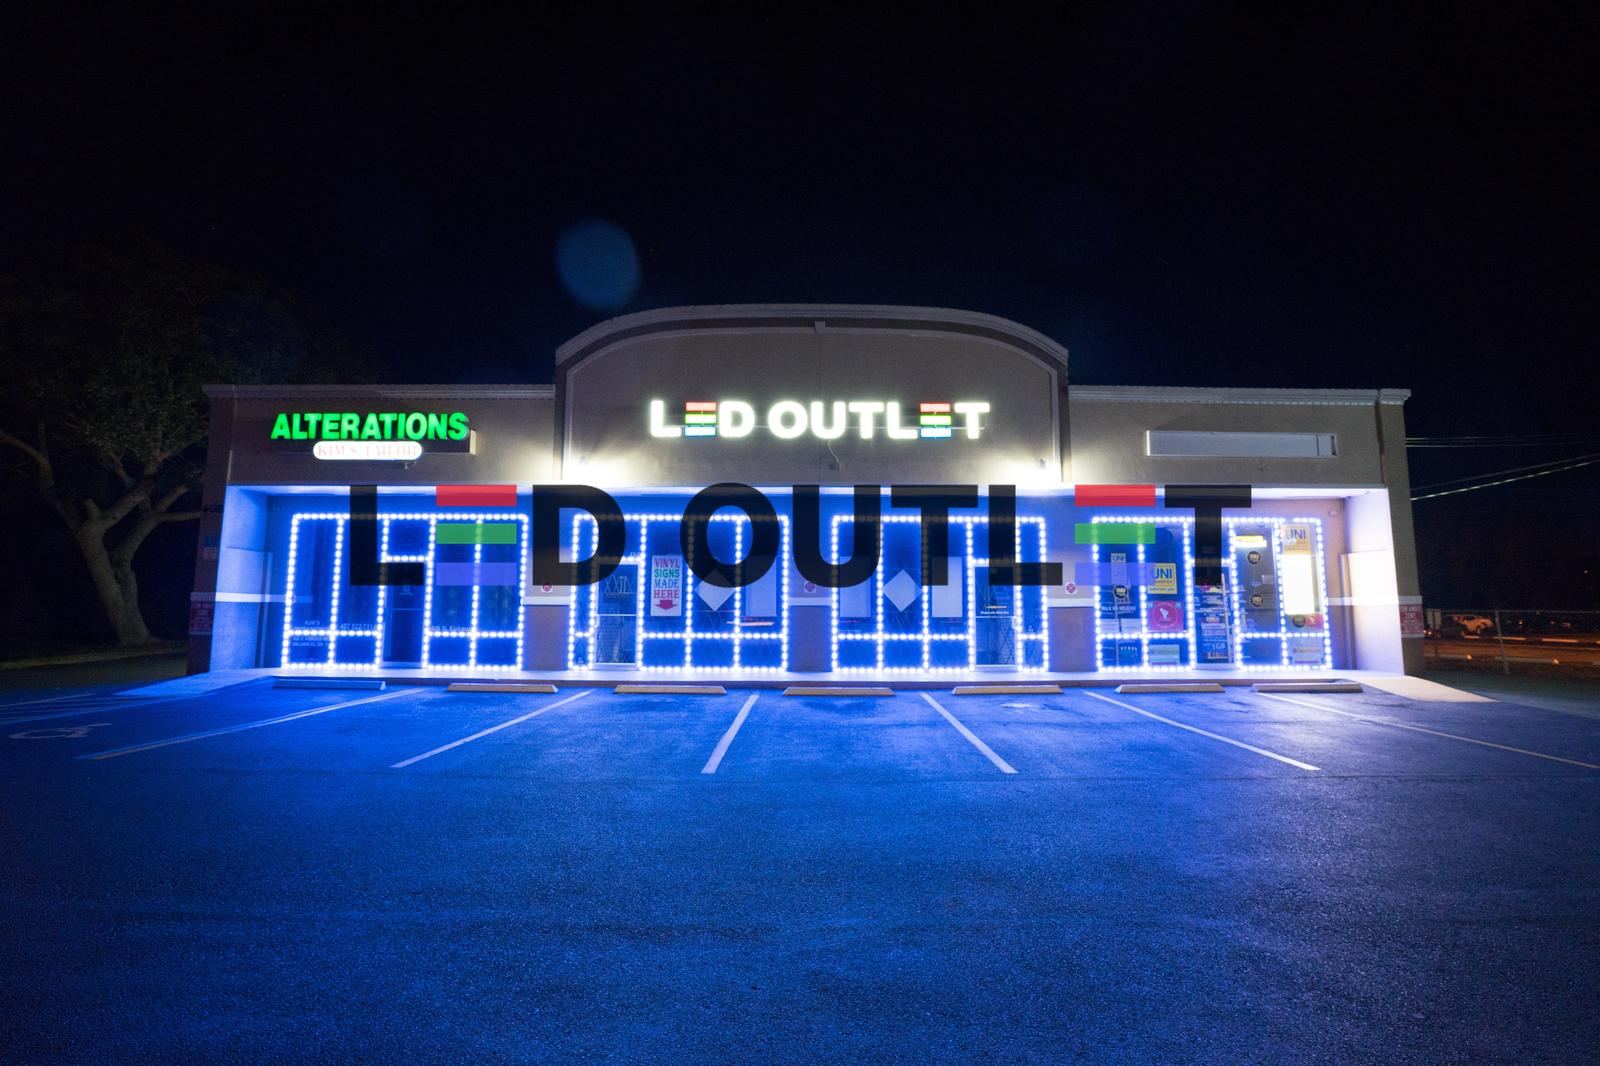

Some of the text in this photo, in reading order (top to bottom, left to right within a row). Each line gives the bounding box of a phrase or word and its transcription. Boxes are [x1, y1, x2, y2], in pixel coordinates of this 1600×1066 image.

[649, 399, 991, 440] LED OUTLET
[270, 411, 469, 441] ALTERATIONS
[654, 558, 680, 568] VINYL
[654, 569, 680, 578] SIGNS
[654, 579, 680, 588] MADE
[653, 590, 680, 599] HERE
